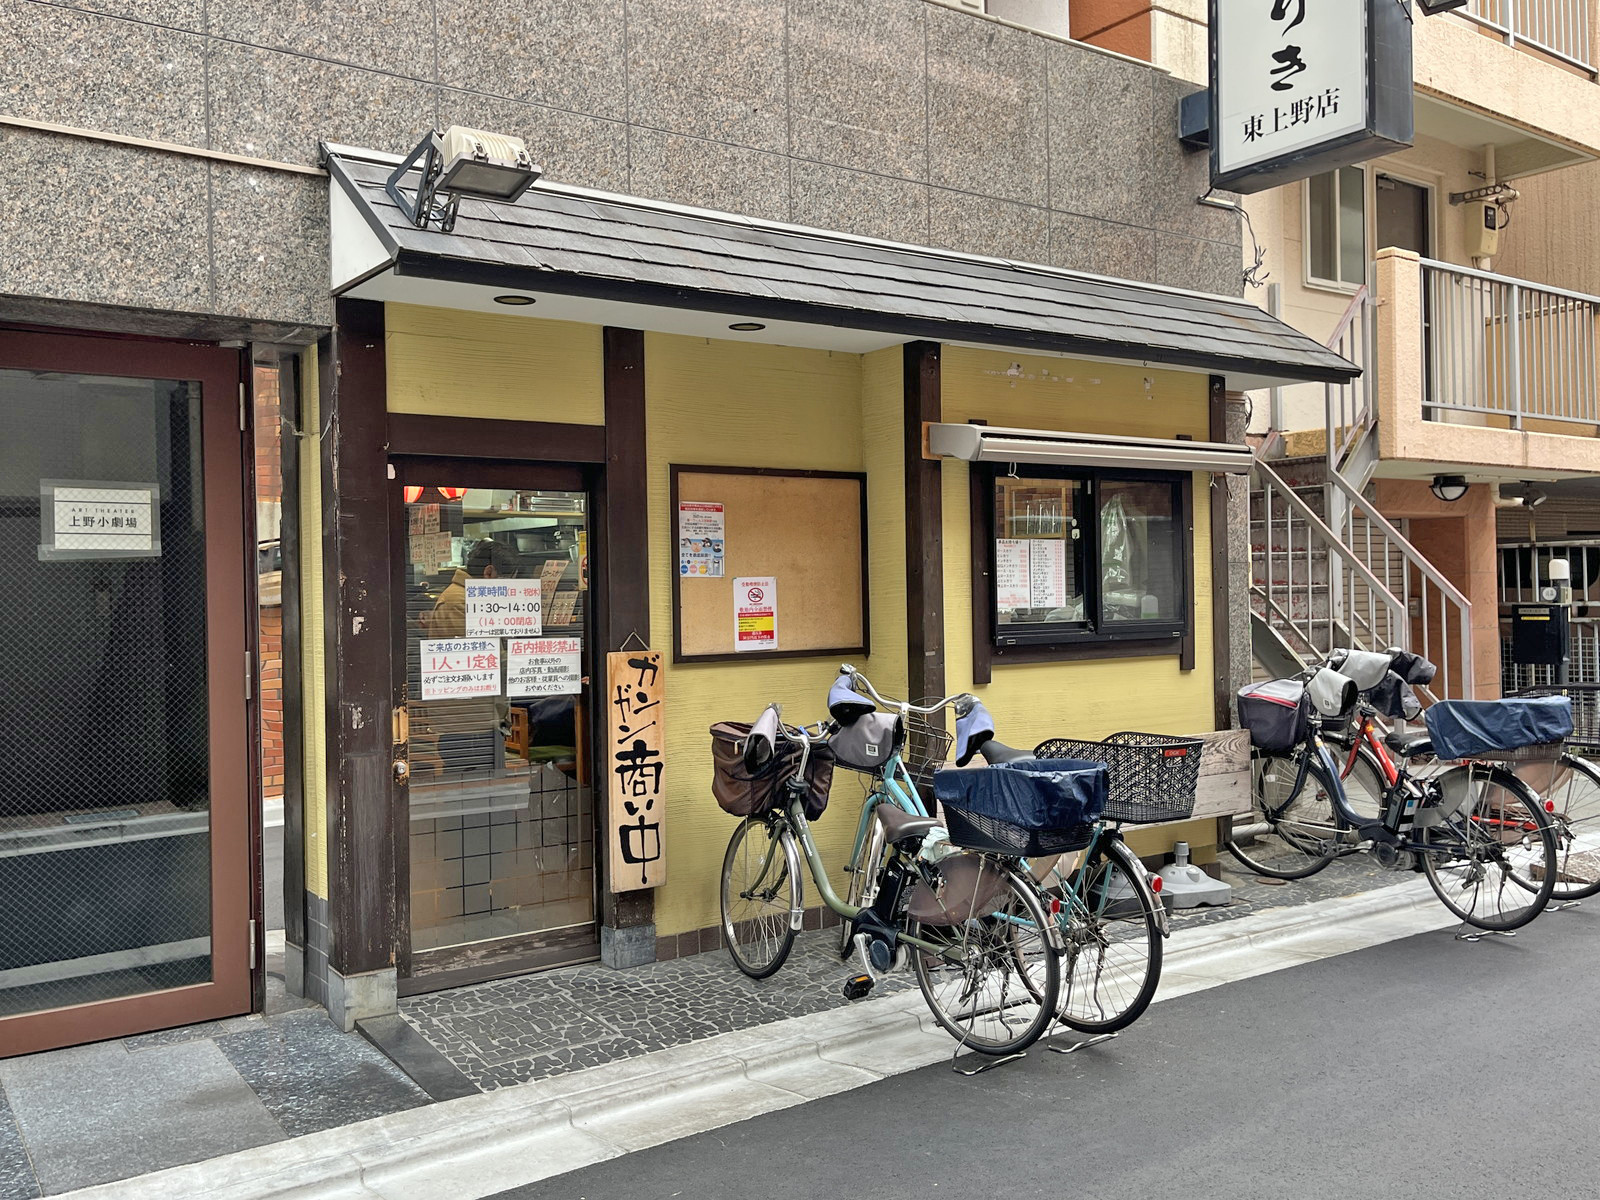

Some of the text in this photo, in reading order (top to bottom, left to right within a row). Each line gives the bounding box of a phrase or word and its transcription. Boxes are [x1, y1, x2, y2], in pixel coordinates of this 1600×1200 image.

[1241, 87, 1340, 145] 東上野店
[69, 515, 137, 528] 上野小劇場
[427, 641, 496, 652] ご来店のお客様へ
[511, 640, 580, 654] 店内撮影禁止
[424, 673, 495, 684] 必ずご注文お願いします
[525, 684, 564, 692] おやめください
